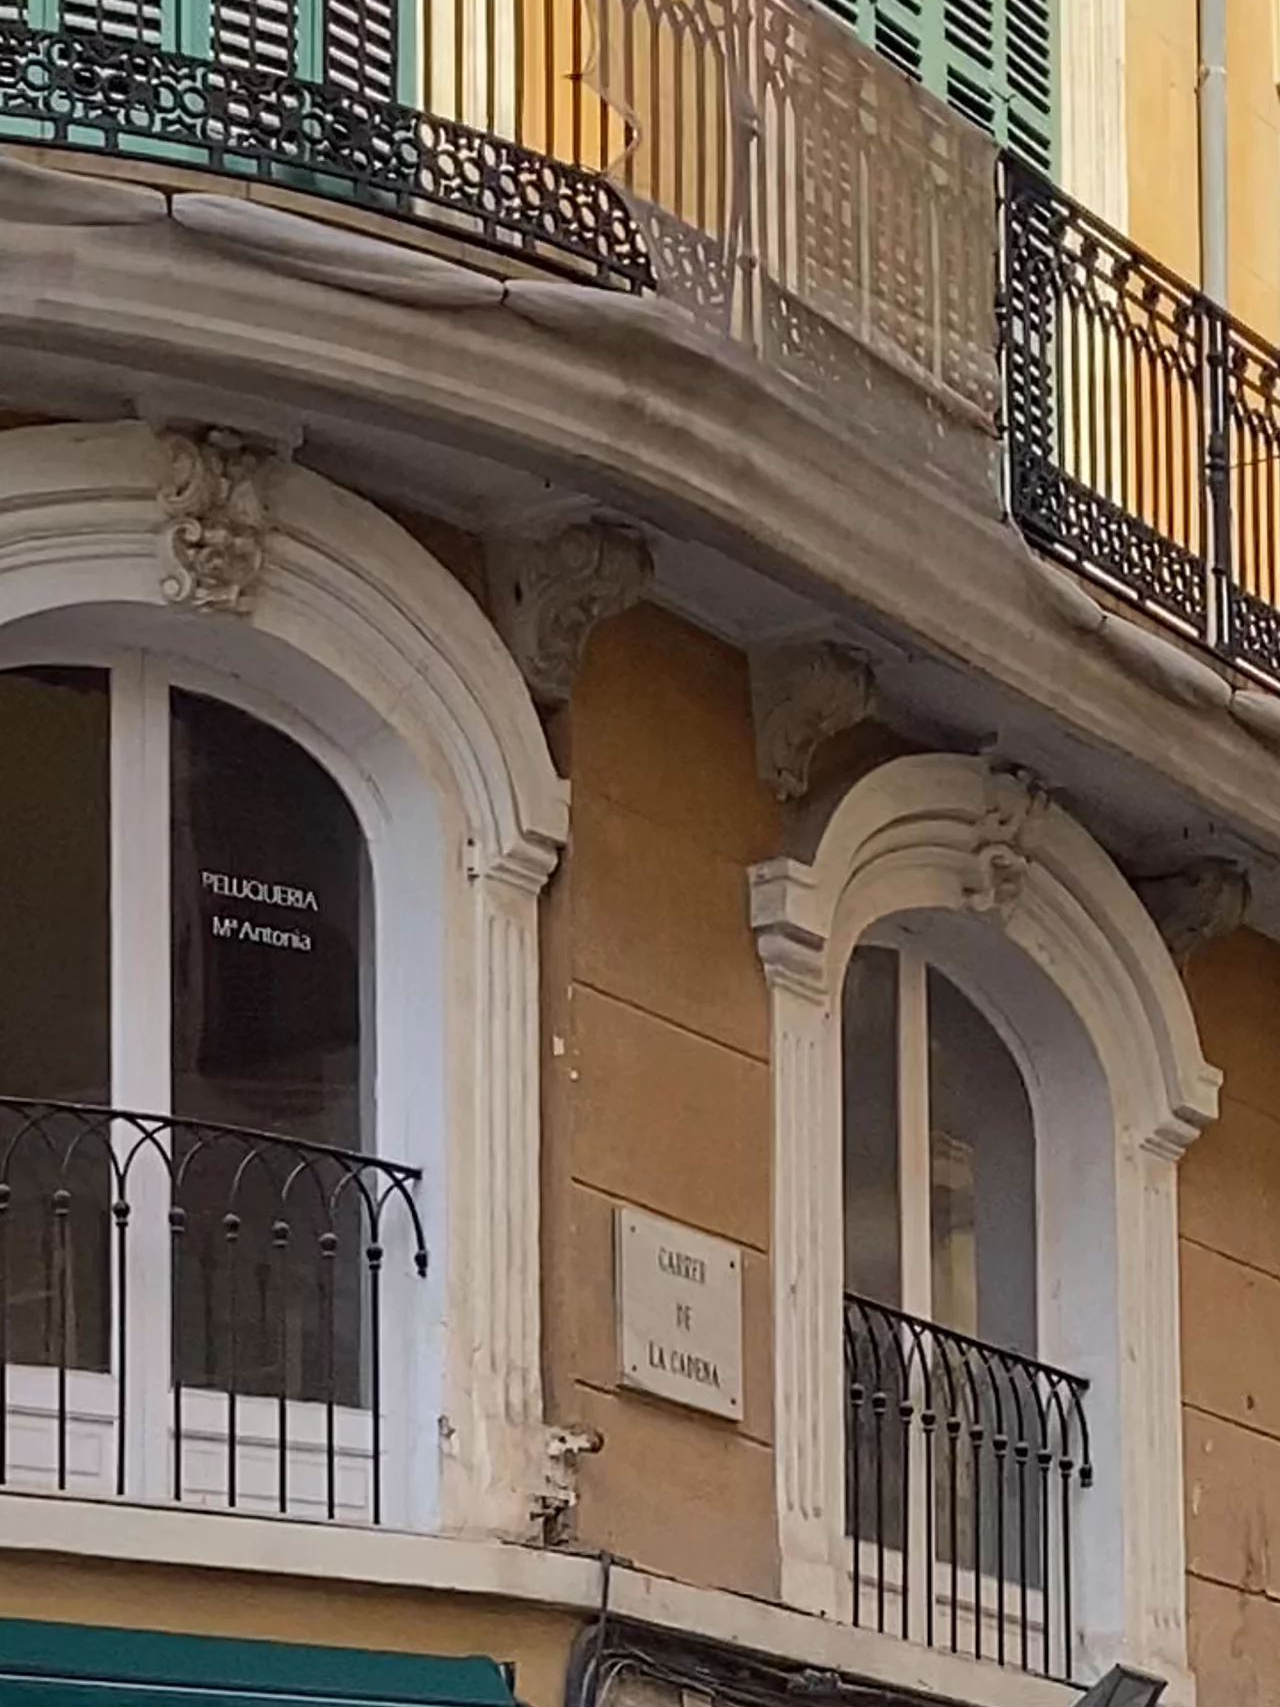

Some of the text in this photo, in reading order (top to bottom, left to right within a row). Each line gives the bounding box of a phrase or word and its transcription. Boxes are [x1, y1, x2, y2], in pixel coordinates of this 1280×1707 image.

[201, 871, 319, 912] PELUQUERIA
[238, 921, 312, 952] Antonia
[658, 1246, 706, 1285] CARRER
[676, 1302, 692, 1332] DE
[648, 1340, 721, 1390] LA CADENA
